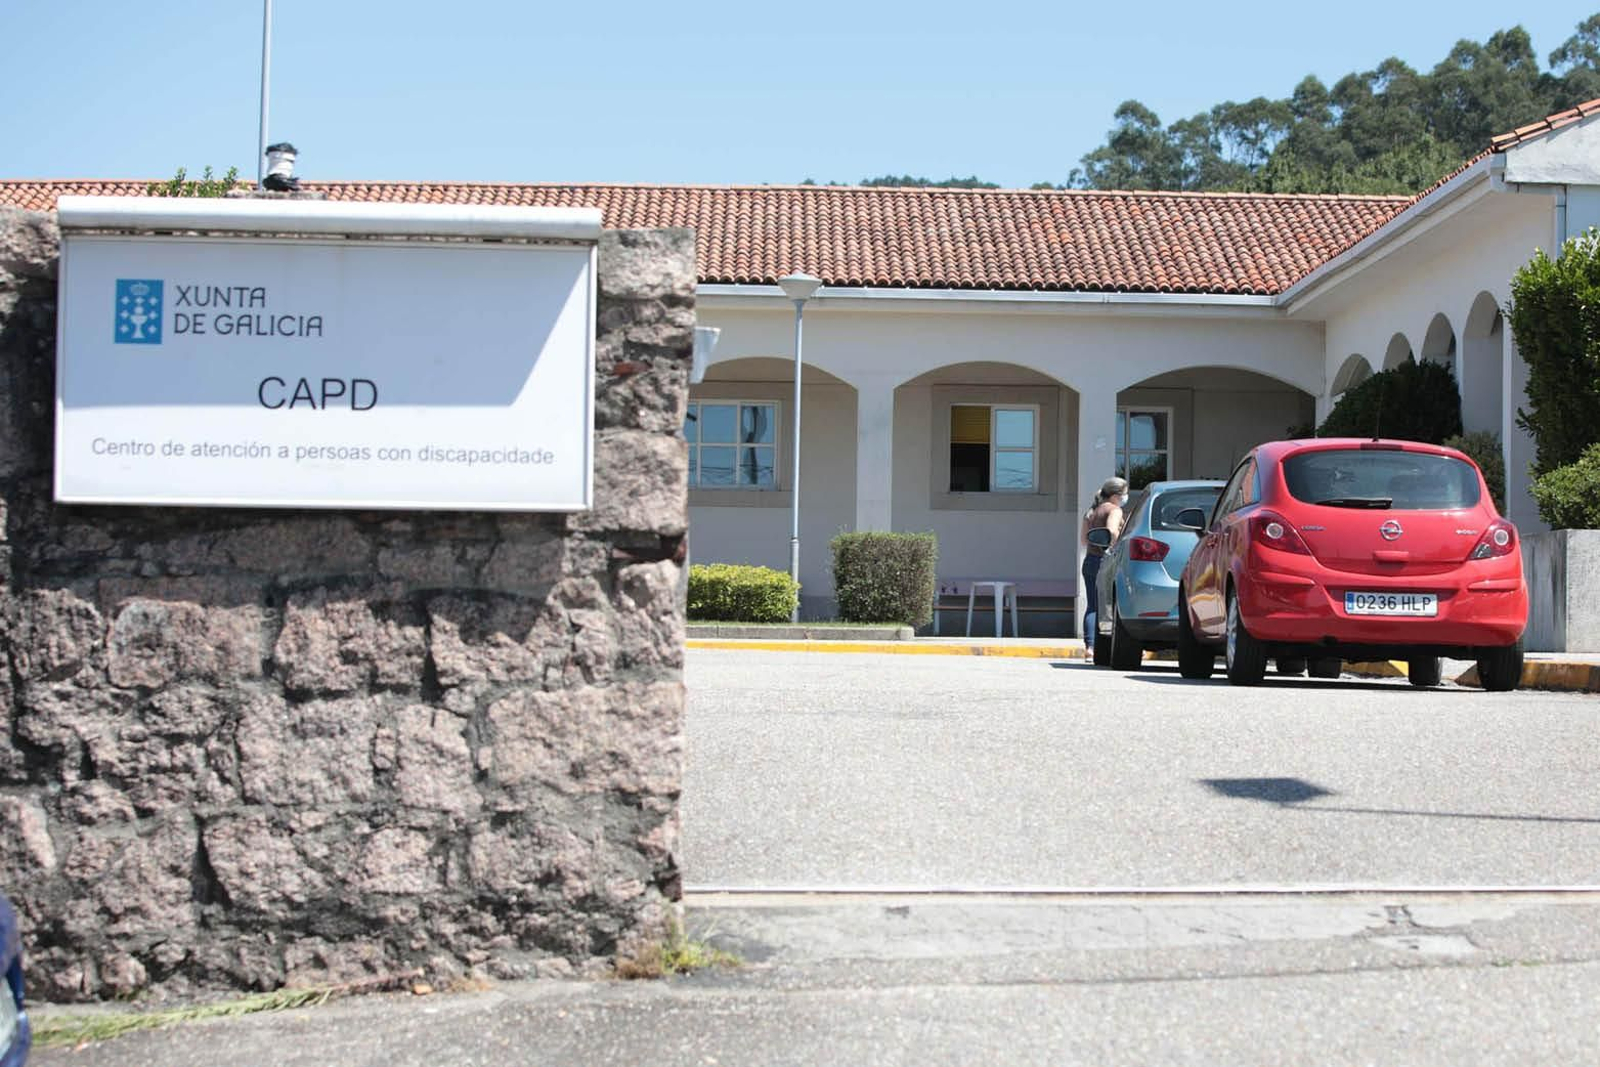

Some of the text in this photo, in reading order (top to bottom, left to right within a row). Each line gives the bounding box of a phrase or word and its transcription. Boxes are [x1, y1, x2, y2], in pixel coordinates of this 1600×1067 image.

[175, 285, 266, 308] XUNTA
[174, 313, 324, 337] DE GALICIA
[258, 376, 378, 411] CAPD
[91, 437, 554, 467] Centro de atención a persoas con discapacidade
[1356, 594, 1431, 611] 0236 HLP
